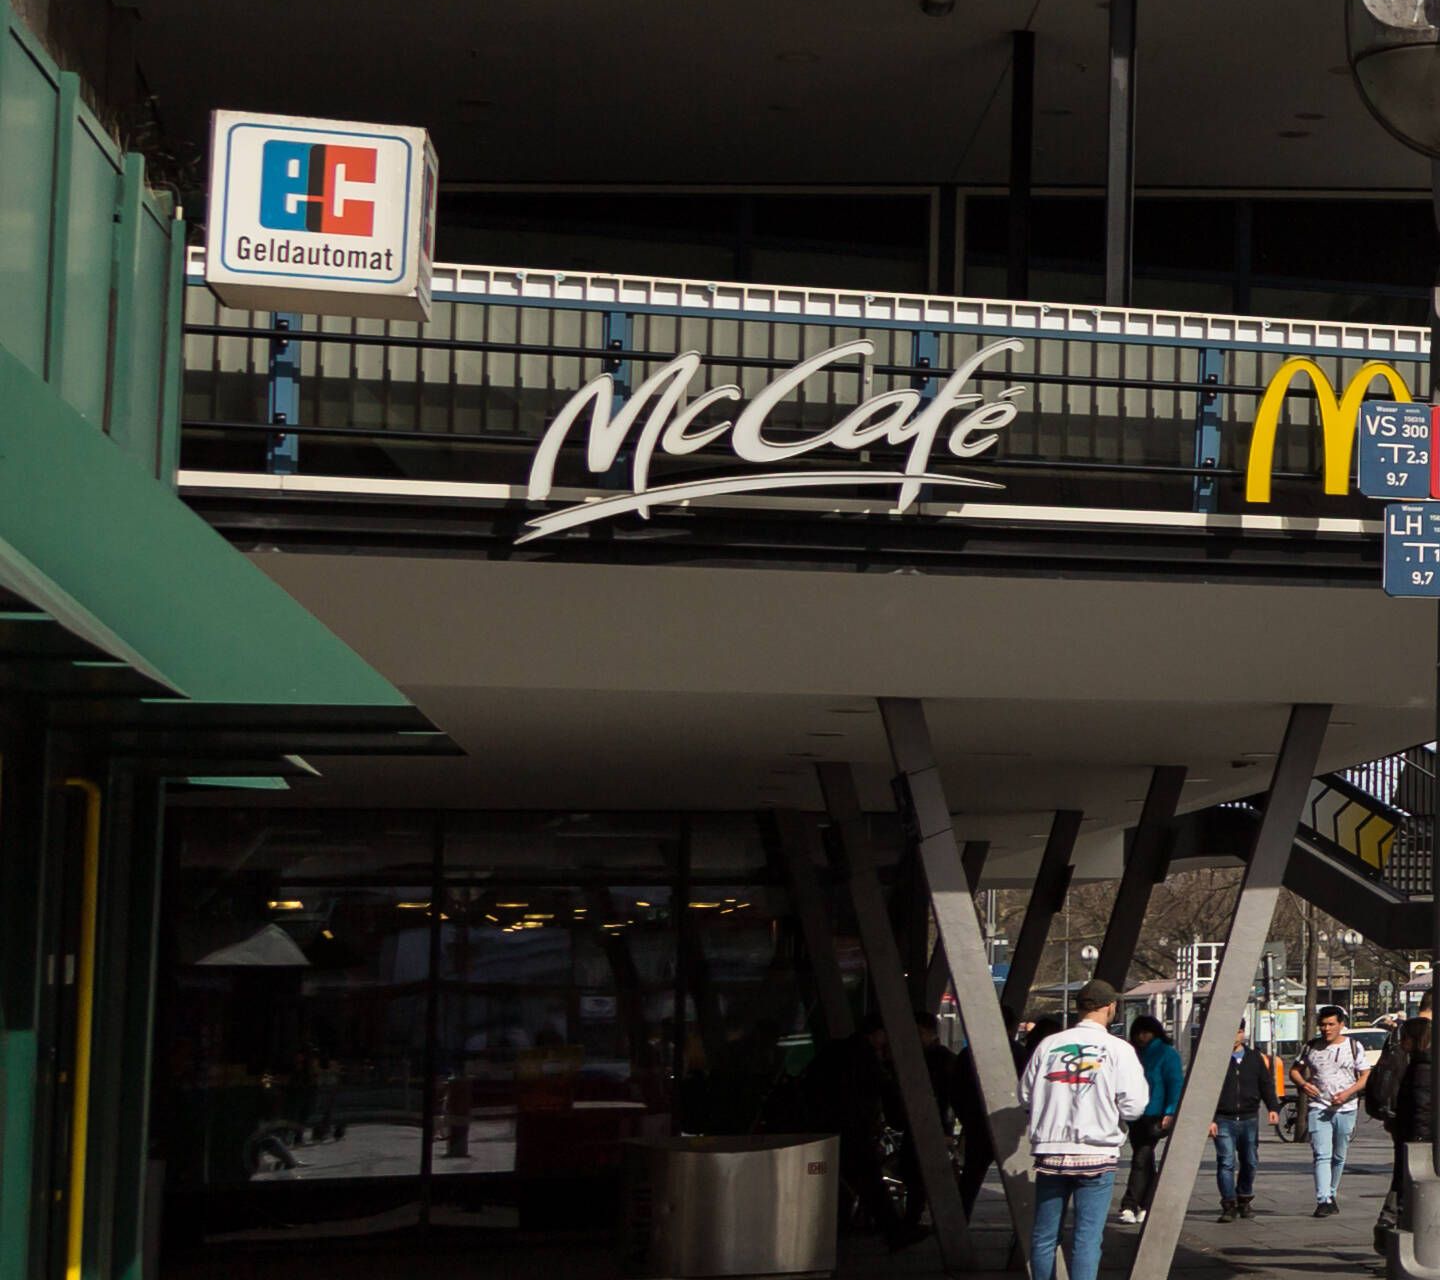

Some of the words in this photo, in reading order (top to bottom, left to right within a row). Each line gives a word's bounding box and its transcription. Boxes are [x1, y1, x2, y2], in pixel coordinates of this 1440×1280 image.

[237, 236, 393, 270] Geldautomat
[528, 338, 1026, 518] McCafé
[1366, 415, 1397, 436] VS
[1402, 425, 1428, 438] 300
[1406, 451, 1428, 464] 2.3
[1386, 473, 1408, 486] 9.7
[1390, 514, 1422, 535] LH
[1412, 572, 1434, 585] 9.7
